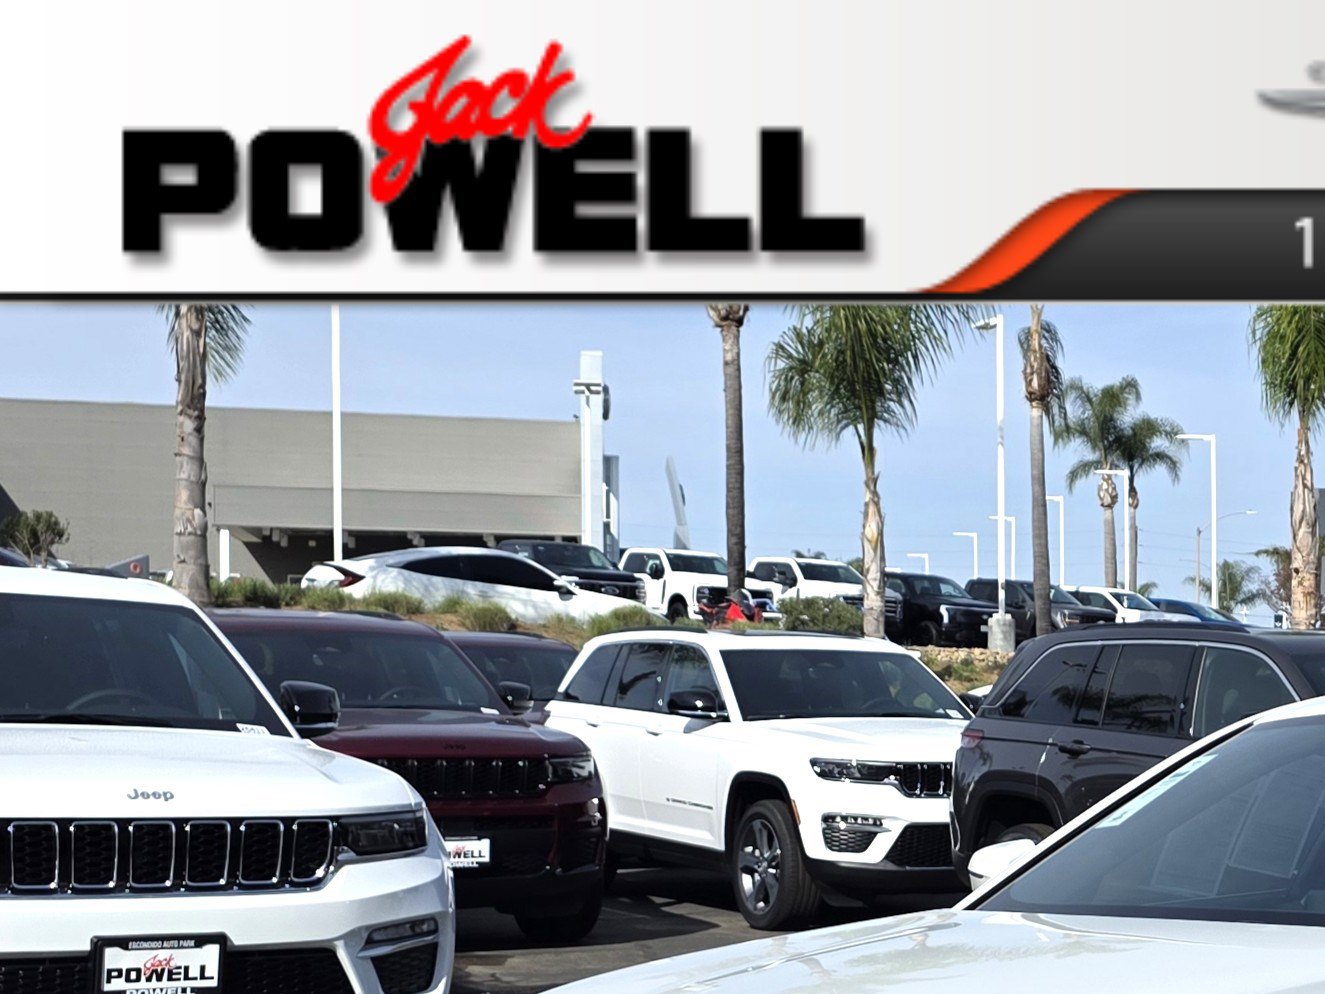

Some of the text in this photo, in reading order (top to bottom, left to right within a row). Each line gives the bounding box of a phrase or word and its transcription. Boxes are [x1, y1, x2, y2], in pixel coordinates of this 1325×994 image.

[127, 788, 174, 801] Jeep
[162, 940, 179, 949] AUTO
[179, 940, 196, 948] PARK
[105, 964, 215, 985] POWELL
